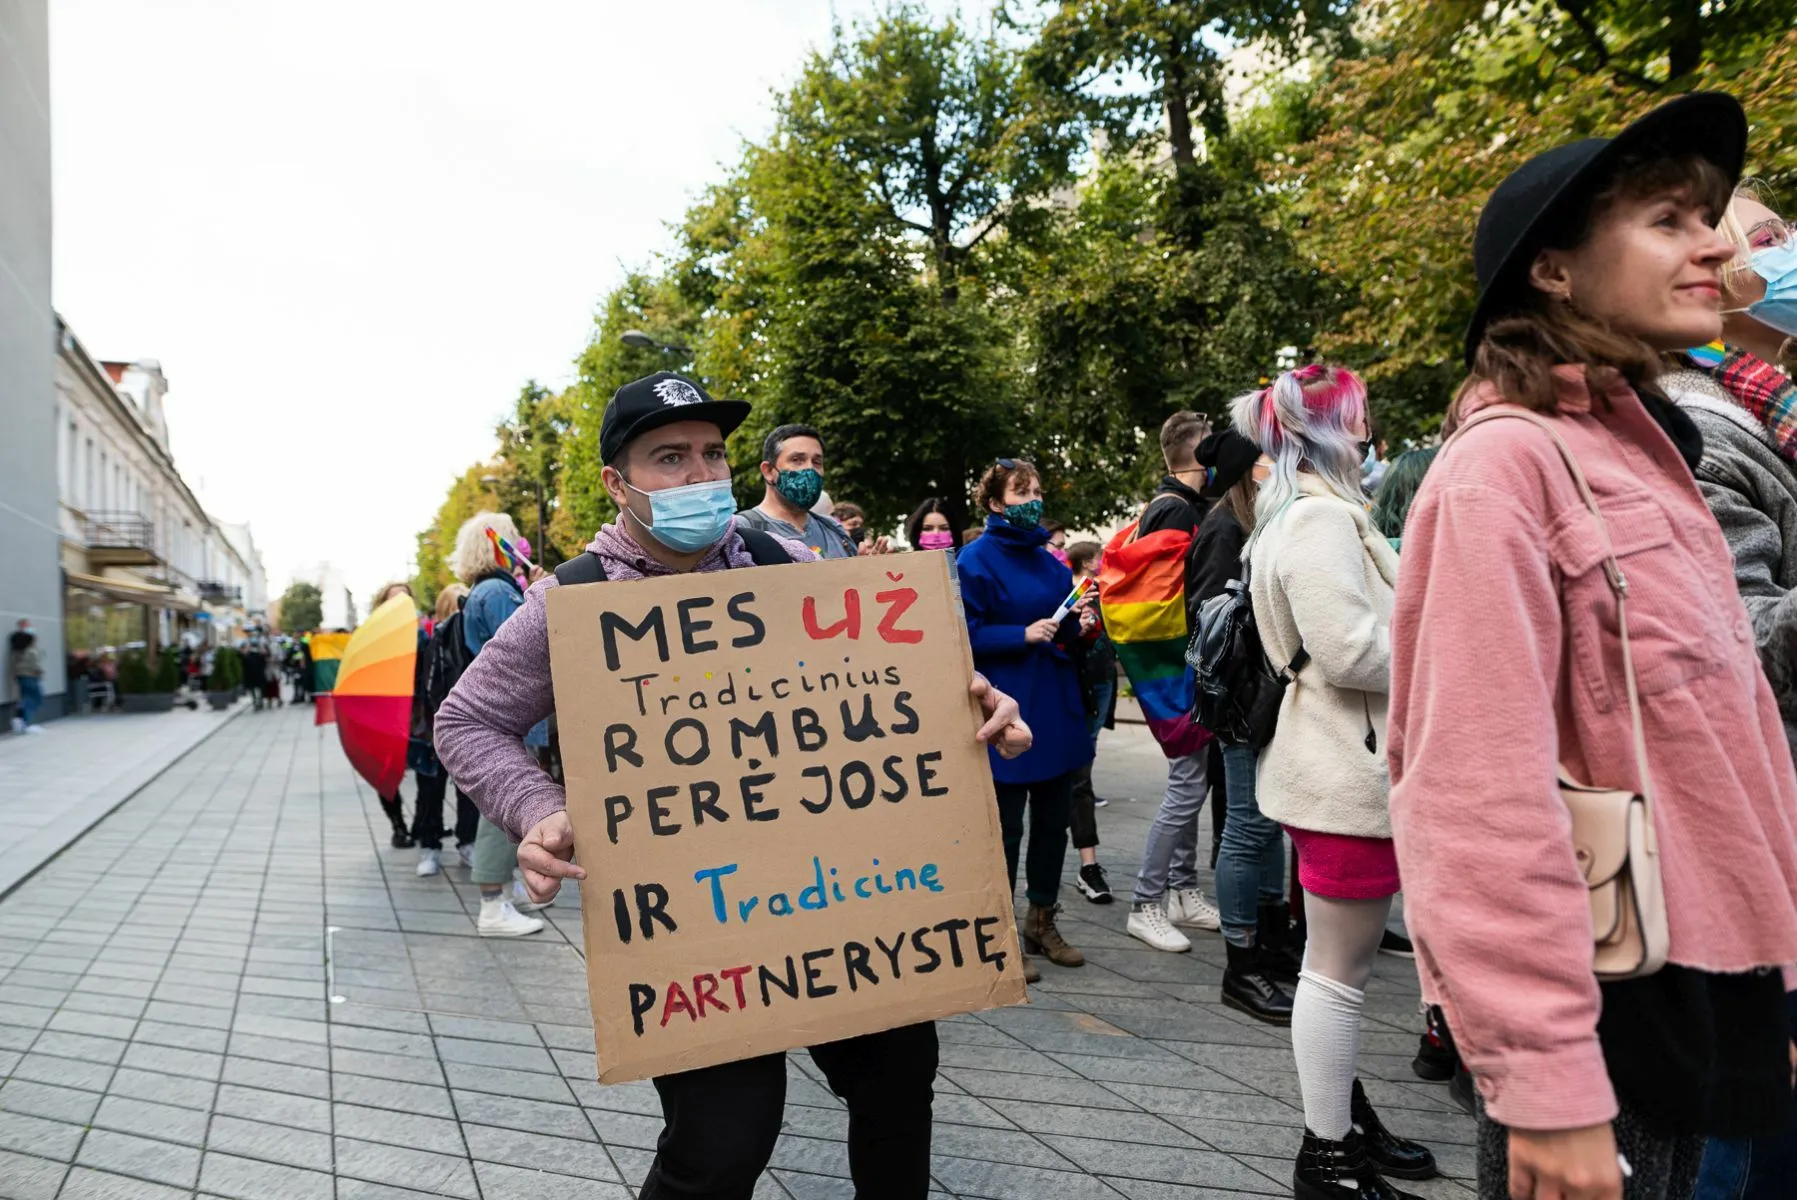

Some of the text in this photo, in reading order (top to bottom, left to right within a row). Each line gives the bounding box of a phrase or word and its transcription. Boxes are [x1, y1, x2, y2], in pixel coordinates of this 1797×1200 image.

[600, 571, 924, 672] MES UŽ
[620, 656, 901, 716] Tradicinius
[603, 691, 920, 772] ROMBUS
[612, 856, 944, 944] IR Tradicinę
[628, 916, 1006, 1037] PARTNERYSTĘ
